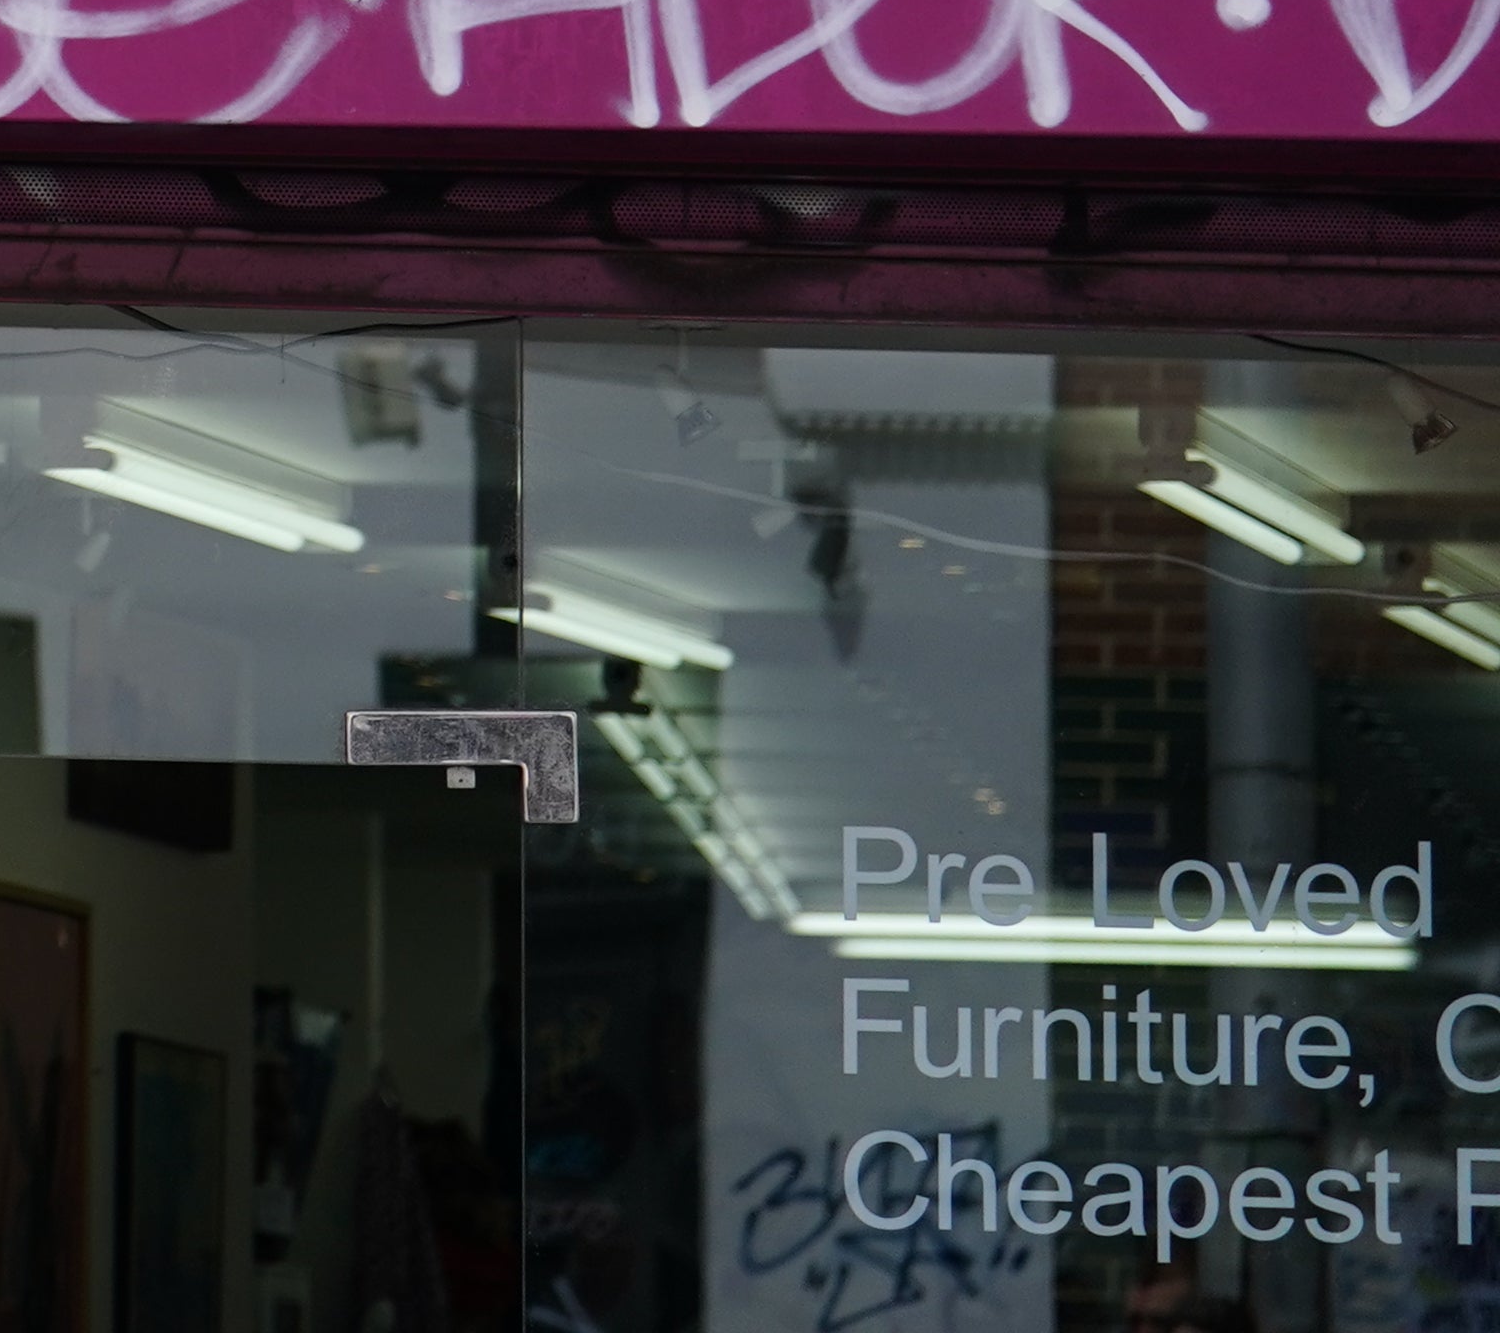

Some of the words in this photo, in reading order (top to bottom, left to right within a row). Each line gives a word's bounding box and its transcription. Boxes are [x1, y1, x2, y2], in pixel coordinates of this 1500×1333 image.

[842, 826, 1035, 926] Pre
[1092, 832, 1433, 939] Loved
[843, 978, 1375, 1108] Furniture,
[844, 1130, 1403, 1264] Cheapest
